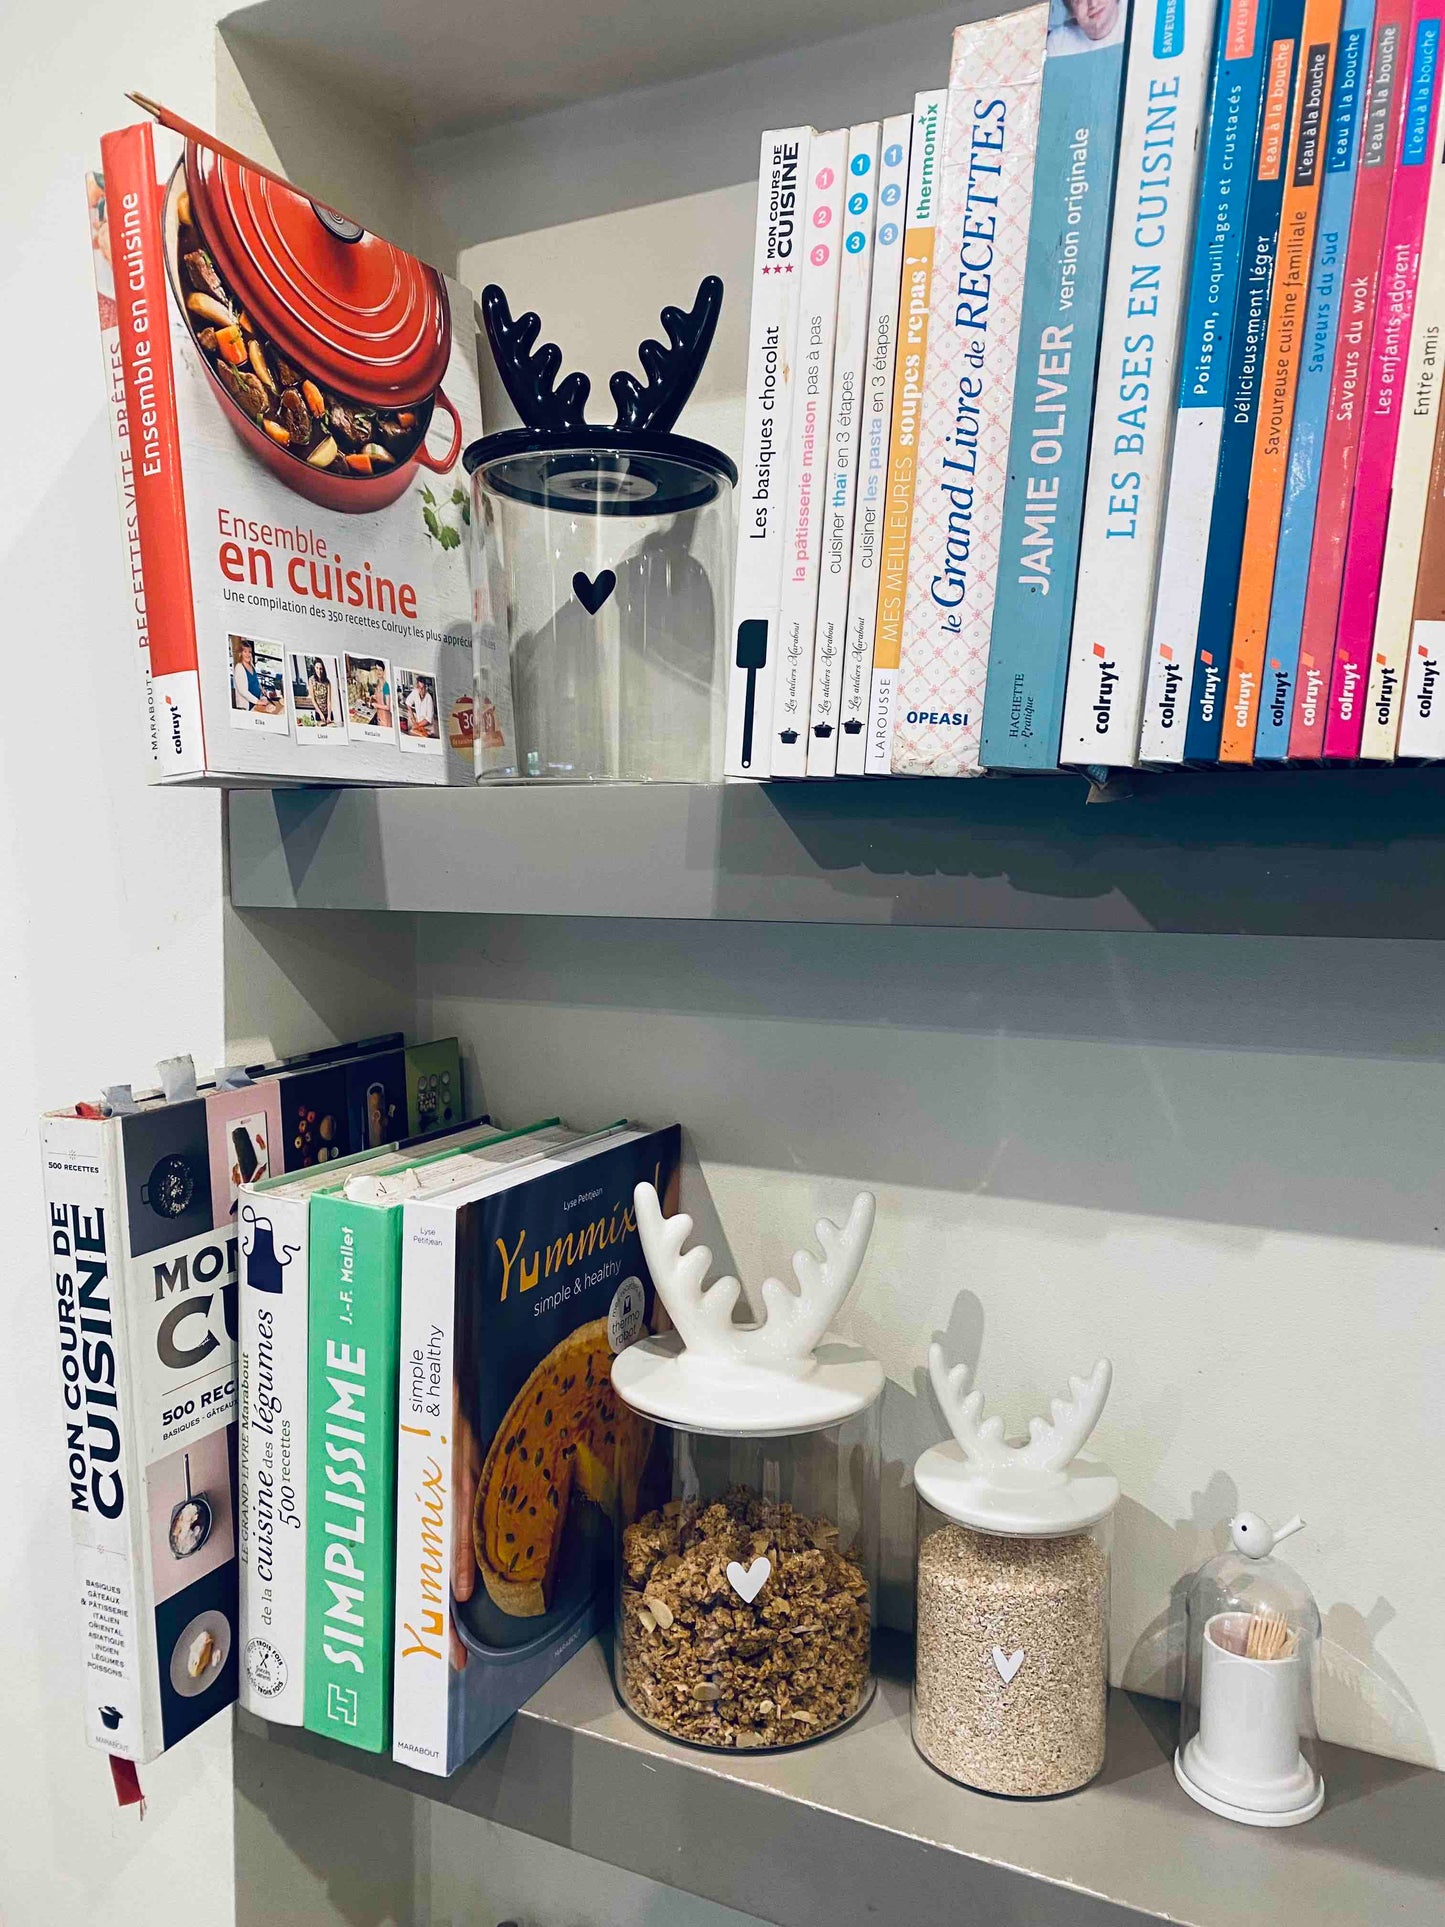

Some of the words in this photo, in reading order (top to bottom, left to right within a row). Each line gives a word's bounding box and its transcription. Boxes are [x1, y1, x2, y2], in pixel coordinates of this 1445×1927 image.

[1163, 0, 1176, 53] SAVEURS
[1270, 42, 1290, 96] bouche
[1307, 53, 1326, 106] bouche
[1342, 33, 1359, 89] bouche
[1376, 27, 1395, 83] bouche
[1267, 103, 1284, 116] la
[1303, 109, 1319, 124] la
[1338, 96, 1352, 108] la
[1374, 89, 1388, 102] la
[1409, 117, 1425, 154] L'eau
[1417, 30, 1436, 83] bouche
[772, 145, 783, 163] DE
[1224, 85, 1242, 170] crustacés
[1332, 129, 1348, 169] L'eau
[1365, 123, 1384, 164] L'eau
[916, 103, 938, 220] thermomix
[1067, 127, 1090, 225] originale
[1134, 77, 1180, 248] CUISINE
[1260, 138, 1278, 176] L'eau
[1298, 137, 1315, 177] L'eau
[769, 170, 781, 222] COURS
[778, 142, 799, 258] CUISINE
[1219, 179, 1231, 195] et
[121, 192, 145, 291] cuisine
[767, 226, 777, 259] MON
[955, 99, 1007, 332] RECETTES
[1058, 231, 1080, 311] version
[1208, 203, 1229, 304] coquillages
[1284, 210, 1307, 286] familiale
[1322, 232, 1338, 264] Sud
[906, 269, 927, 344] repas
[1127, 264, 1161, 319] EN
[1316, 274, 1332, 296] du
[1352, 276, 1369, 313] wok
[1388, 243, 1411, 315] adorent
[130, 300, 149, 332] en
[808, 315, 822, 345] pas
[873, 314, 890, 370] étapes
[1233, 290, 1262, 424] Délicieusement
[1249, 235, 1273, 288] léger
[1277, 292, 1297, 353] cuisine
[1309, 301, 1330, 373] Saveurs
[1345, 319, 1363, 342] du
[759, 325, 779, 410] chocolat
[964, 341, 985, 368] de
[1193, 312, 1219, 394] Poisson,
[1381, 317, 1401, 386] enfants
[1423, 325, 1440, 366] amis
[133, 339, 161, 477] Ensemble
[807, 366, 819, 395] pas
[838, 371, 855, 426] étapes
[872, 375, 885, 386] 3
[874, 393, 884, 412] en
[900, 354, 923, 448] soupes
[1030, 324, 1074, 465] OLIVER
[1114, 334, 1154, 455] BASES
[1265, 359, 1289, 455] Savoureuse
[1337, 350, 1359, 421] Saveurs
[1374, 391, 1393, 415] Les
[1414, 372, 1433, 416] Entre
[801, 401, 816, 467] maison
[837, 431, 850, 443] 3
[869, 417, 883, 469] pasta
[942, 377, 982, 476] Livre
[753, 417, 777, 501] basiques
[838, 448, 849, 467] en
[833, 473, 847, 508] thaï
[864, 475, 877, 501] les
[1106, 471, 1140, 539] LES
[218, 509, 327, 558] Ensemble
[750, 507, 767, 538] Les
[795, 473, 812, 562] pâtisserie
[829, 512, 844, 574] cuisiner
[861, 507, 876, 569] cuisiner
[886, 457, 912, 591] MEILLEURES
[1018, 477, 1059, 595] JAMIE
[931, 485, 973, 608] Grand
[219, 541, 273, 588] en
[288, 554, 417, 618] cuisine
[792, 567, 805, 583] la
[223, 588, 245, 603] Une
[247, 594, 307, 615] compilation
[310, 603, 326, 618] des
[328, 610, 343, 623] 350
[345, 613, 380, 630] recettes
[382, 619, 412, 637] Colruyt
[413, 625, 424, 638] les
[426, 629, 442, 643] plus
[852, 617, 868, 662] Marabout
[881, 596, 901, 642] MES
[941, 614, 962, 634] le
[787, 622, 803, 666] Marabout
[821, 622, 837, 666] Marabout
[146, 679, 158, 750] MARABOUT
[849, 696, 862, 711] Les
[1009, 673, 1024, 738] HACHETTE
[1093, 661, 1119, 734] colruyt
[1159, 664, 1182, 728] colruyt
[1201, 666, 1220, 722] colruyt
[1234, 672, 1253, 728] colruyt
[1271, 671, 1289, 727] colruyt
[1303, 669, 1323, 726] colruyt
[1338, 663, 1360, 720] colruyt
[1377, 667, 1398, 725] colruyt
[1418, 660, 1440, 718] colruyt
[171, 706, 182, 754] colruyt
[875, 678, 890, 759] LAROUSSE
[907, 711, 969, 726] OPEASI
[1021, 696, 1034, 738] Pratique
[64, 1164, 99, 1173] RECETTES
[50, 1202, 71, 1257] DE
[564, 1199, 577, 1211] Lyse
[340, 1226, 354, 1283] Mallet
[496, 1201, 638, 1302] Yummix
[339, 1291, 353, 1325] J.-F.
[534, 1285, 571, 1317] simple
[573, 1277, 582, 1295] &
[584, 1259, 622, 1289] healthy
[56, 1272, 82, 1411] COURS
[612, 1310, 640, 1335] thermo
[615, 1325, 637, 1347] robot
[70, 1203, 124, 1520] CUISINE
[252, 1309, 281, 1435] légumes
[409, 1349, 424, 1413] simple
[427, 1325, 444, 1399] healthy
[162, 1400, 195, 1426] 500
[241, 1352, 250, 1430] Marabout
[163, 1417, 200, 1441] BASIQUES
[261, 1441, 273, 1469] des
[280, 1420, 291, 1482] recettes
[66, 1422, 89, 1513] MON
[241, 1434, 249, 1481] LIVRE
[240, 1483, 249, 1546] GRAND
[252, 1471, 274, 1582] cuisine
[278, 1485, 301, 1529] 500
[323, 1340, 366, 1674] SIMPLISSIME
[402, 1456, 447, 1660] Yummix
[86, 1580, 120, 1594] BASIQUES
[88, 1590, 120, 1604] GÂTEAUX
[88, 1600, 128, 1617] PÂTISSERIE
[261, 1588, 272, 1602] la
[88, 1621, 123, 1636] ORIENTAL
[88, 1632, 125, 1647] ASIATIQUE
[93, 1613, 120, 1625] ITALIEN
[261, 1607, 272, 1625] de
[91, 1653, 125, 1668] LÉGUMES
[95, 1644, 119, 1656] INDIEN
[398, 1741, 439, 1759] MARABOUT
